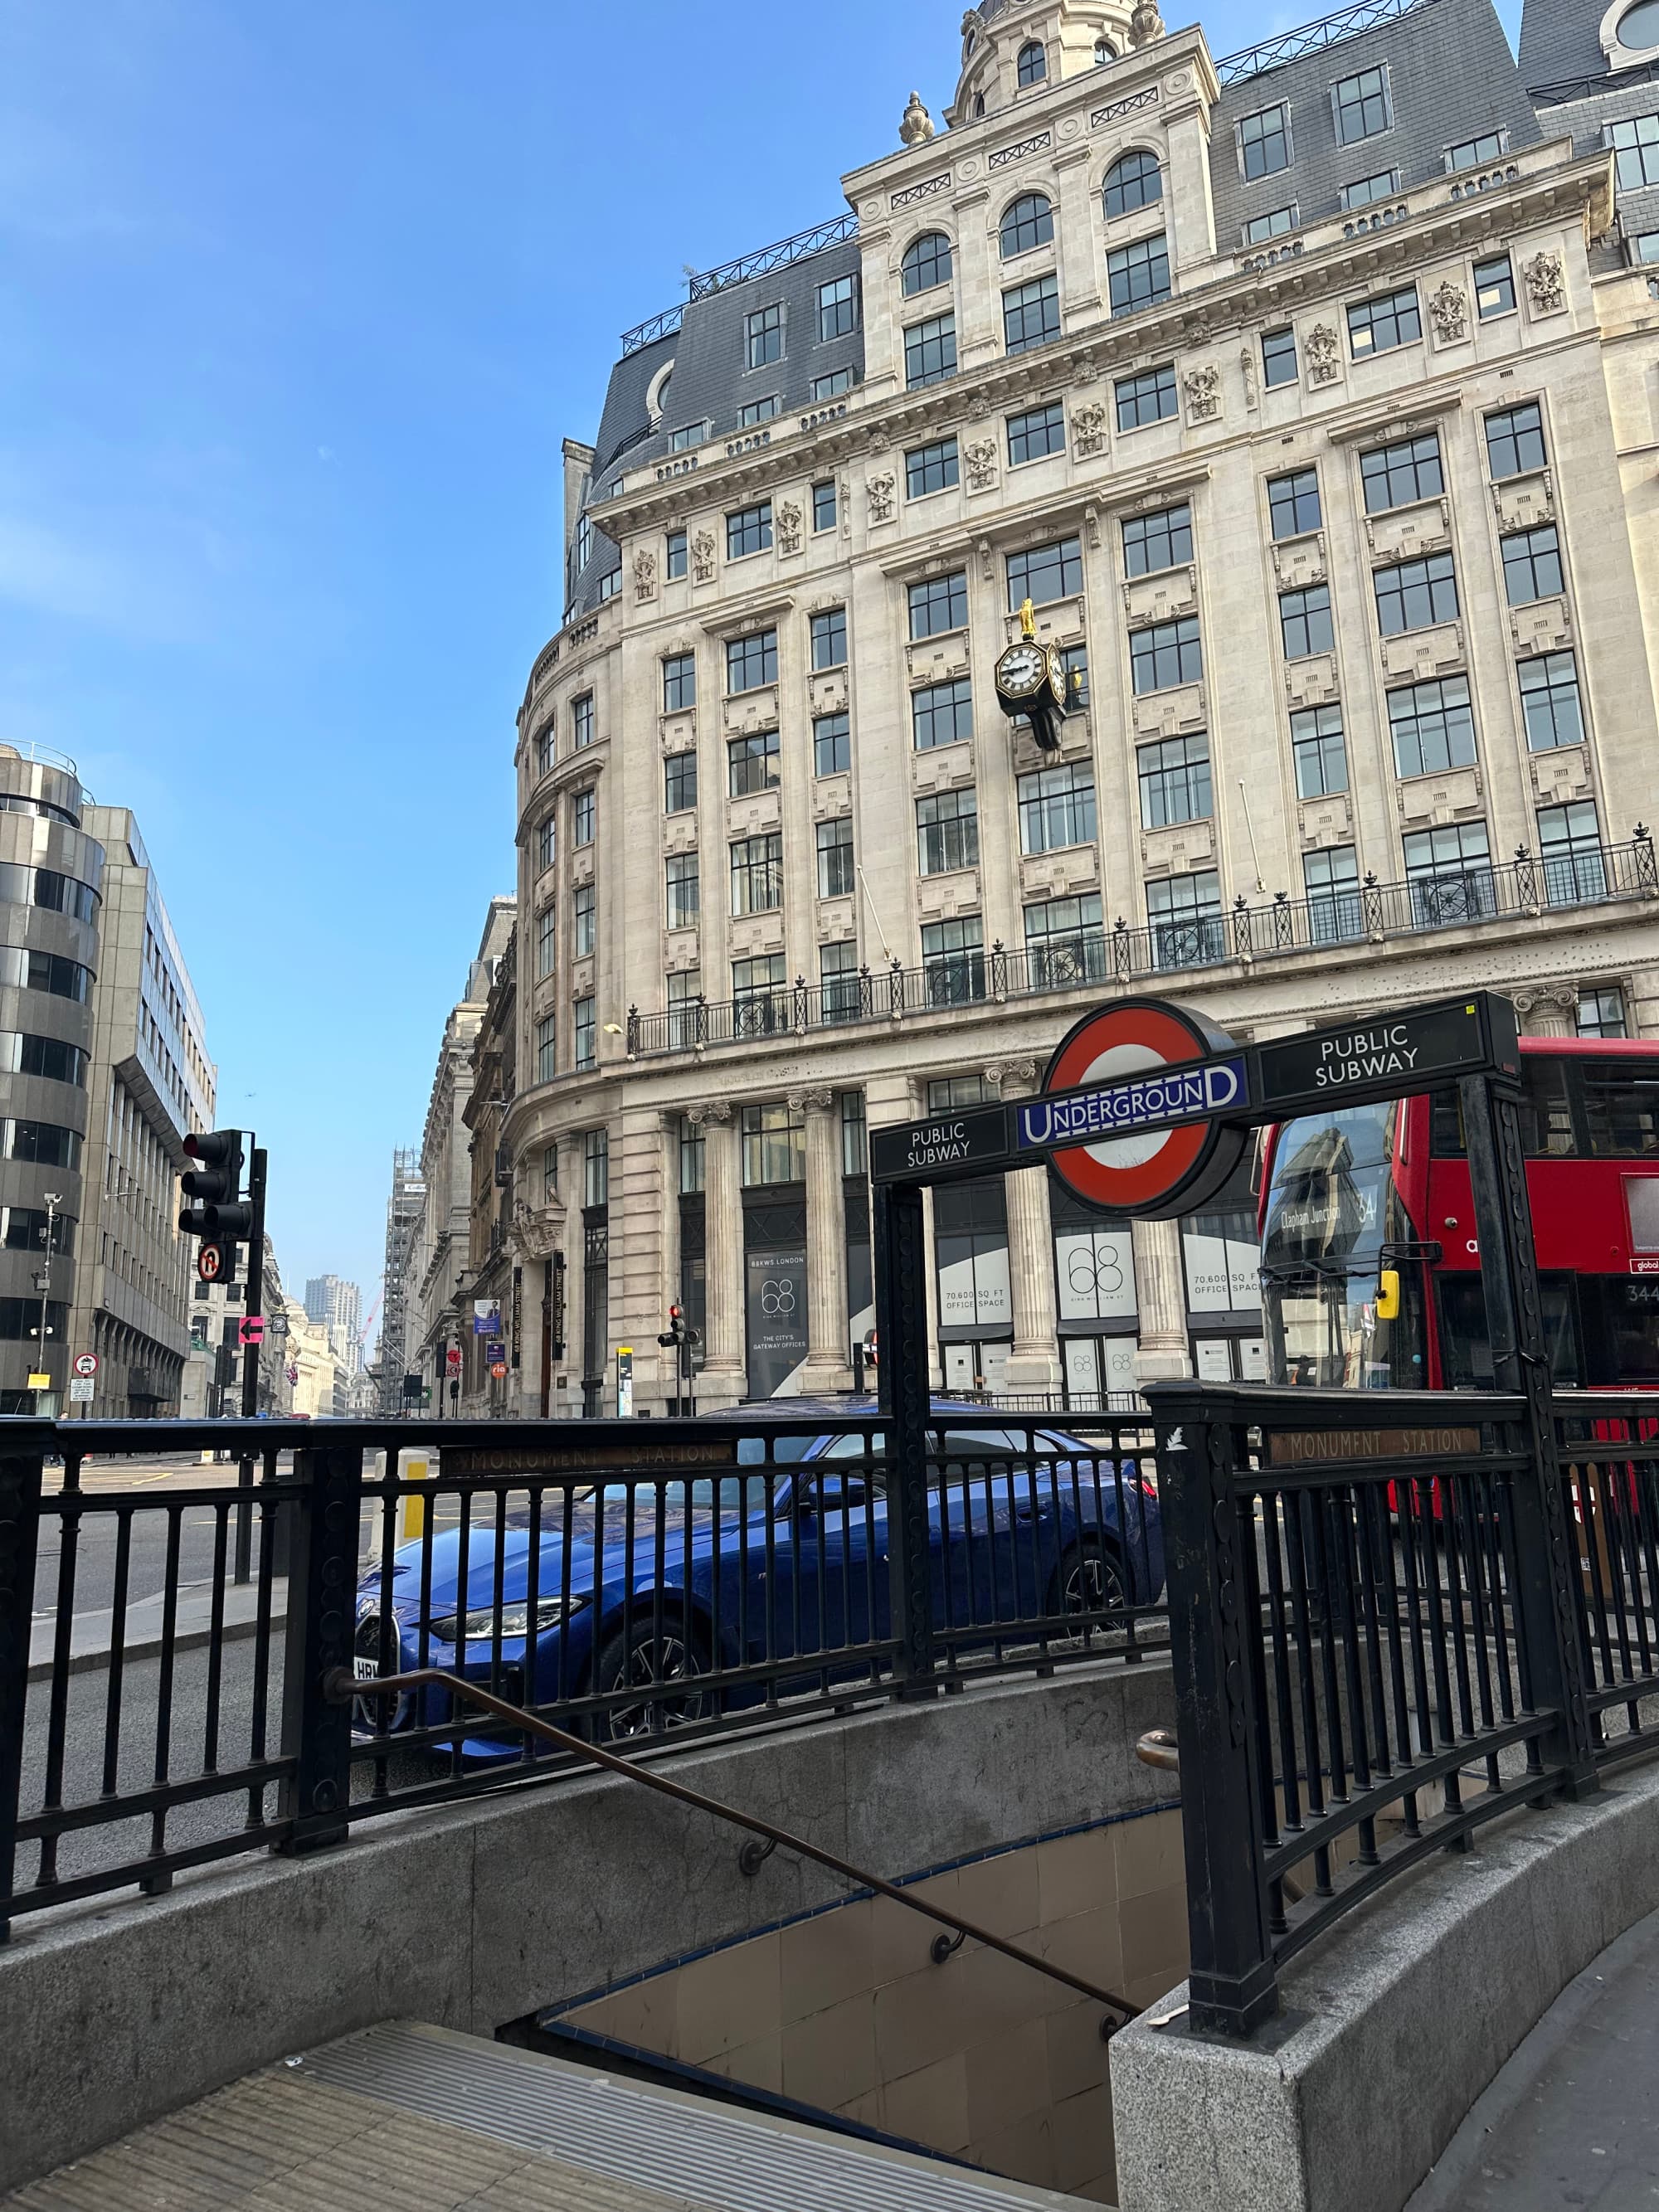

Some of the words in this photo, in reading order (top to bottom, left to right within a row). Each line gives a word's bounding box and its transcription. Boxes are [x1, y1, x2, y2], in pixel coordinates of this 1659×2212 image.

[1321, 1025, 1408, 1062] PUBLIC
[1316, 1048, 1418, 1087] SUBWAY
[1024, 1065, 1238, 1144] UNDERGROUND
[912, 1122, 966, 1148] PUBLIC
[907, 1141, 971, 1168] SUBWAY
[1281, 1209, 1310, 1232] Clapham
[1311, 1205, 1340, 1224] Junction
[776, 1257, 804, 1265] LONDON
[1068, 1246, 1123, 1294] 68
[1637, 1261, 1658, 1271] global
[1194, 1286, 1228, 1294] OFFICE
[1232, 1273, 1245, 1282] SQ
[761, 1279, 795, 1314] 68
[946, 1300, 975, 1309] OFFICE
[978, 1299, 1005, 1307] SPACE
[978, 1290, 989, 1298] SQ
[493, 1364, 505, 1373] ria
[1073, 1354, 1092, 1372] 68
[1112, 1354, 1131, 1371] 68
[1291, 1431, 1381, 1458] MONUMENT
[1403, 1430, 1462, 1452] STATION
[470, 1449, 597, 1471] MONUMENT
[632, 1445, 715, 1464] STATION
